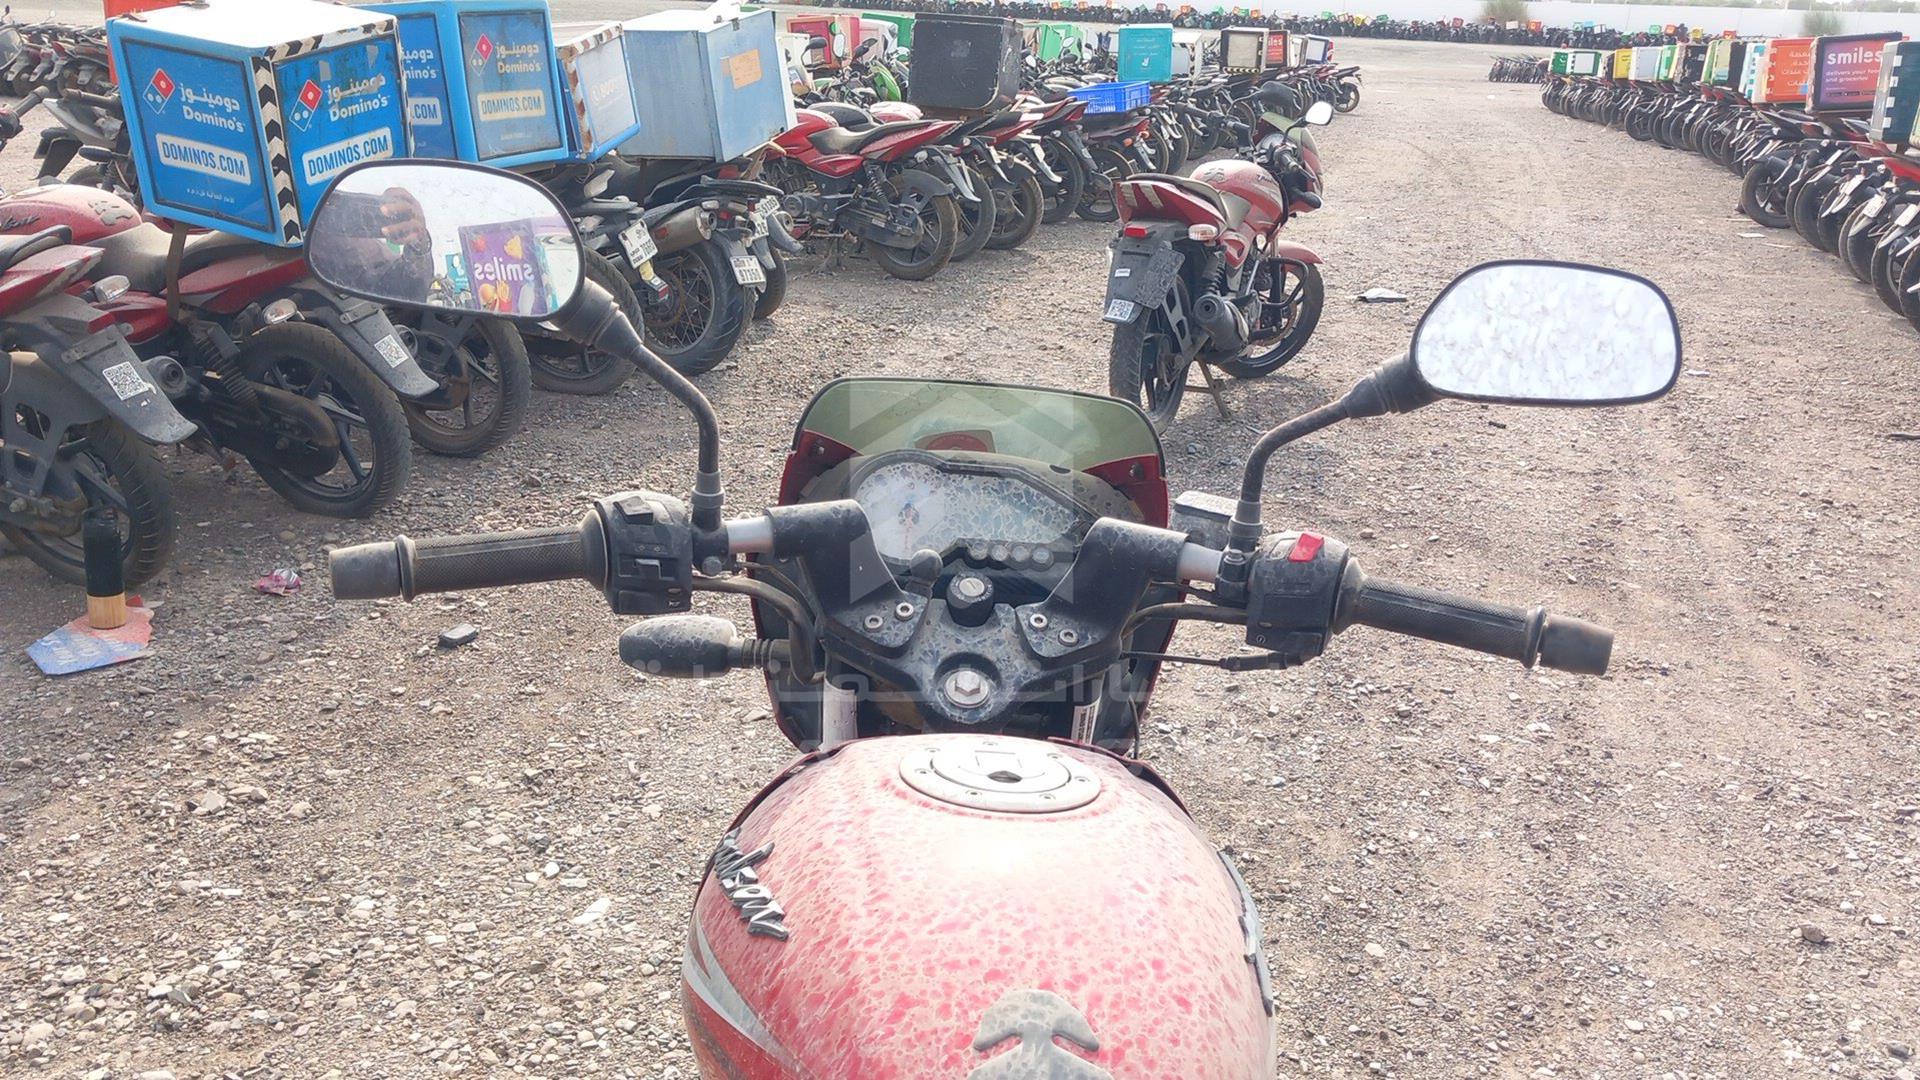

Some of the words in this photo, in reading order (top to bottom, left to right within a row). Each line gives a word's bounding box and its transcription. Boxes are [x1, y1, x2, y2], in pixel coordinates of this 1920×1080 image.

[497, 60, 541, 74] Domino's
[1827, 47, 1883, 64] smiles
[179, 82, 240, 113] دومينوز
[328, 93, 389, 122] Domino's
[481, 96, 542, 115] DOMINOS.COM
[182, 105, 245, 133] Domino's
[161, 141, 246, 177] DOMINOS.COM
[308, 134, 390, 177] DOMINOS.COM
